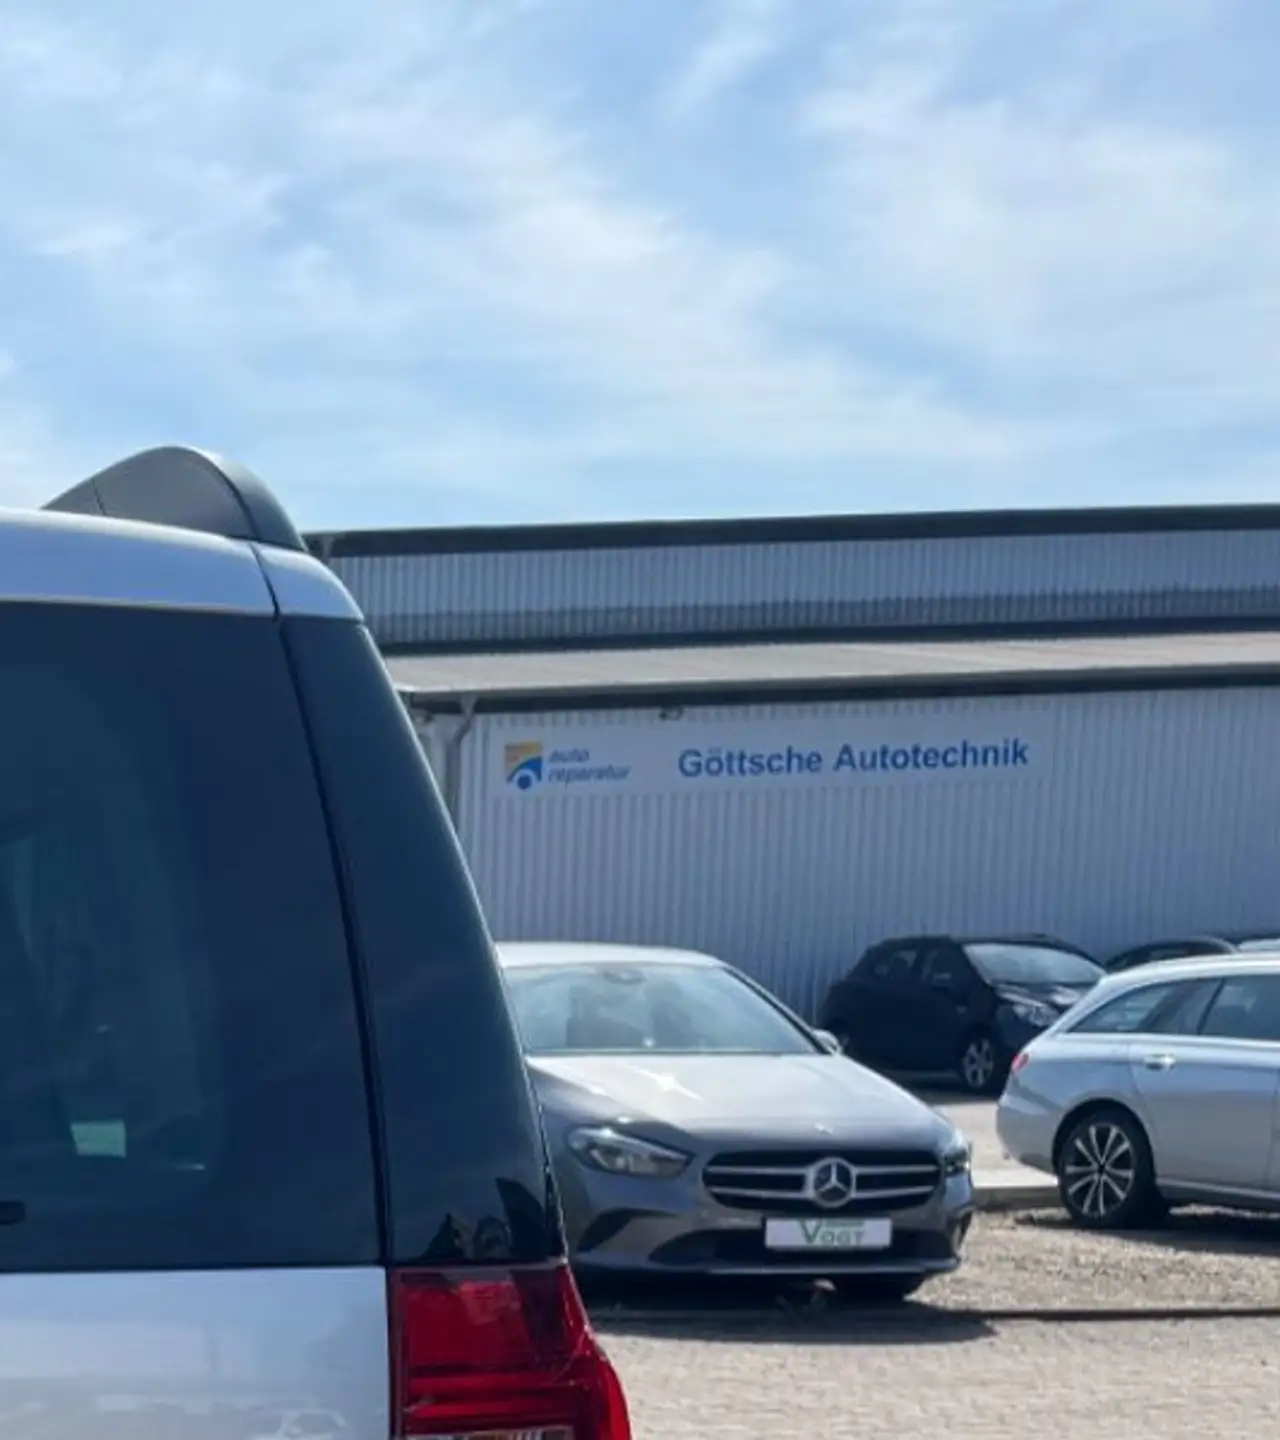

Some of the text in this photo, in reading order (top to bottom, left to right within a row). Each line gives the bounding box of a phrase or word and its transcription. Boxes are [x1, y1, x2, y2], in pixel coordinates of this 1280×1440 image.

[549, 748, 589, 763] auto
[678, 739, 1029, 778] Göttsche Autotechnik
